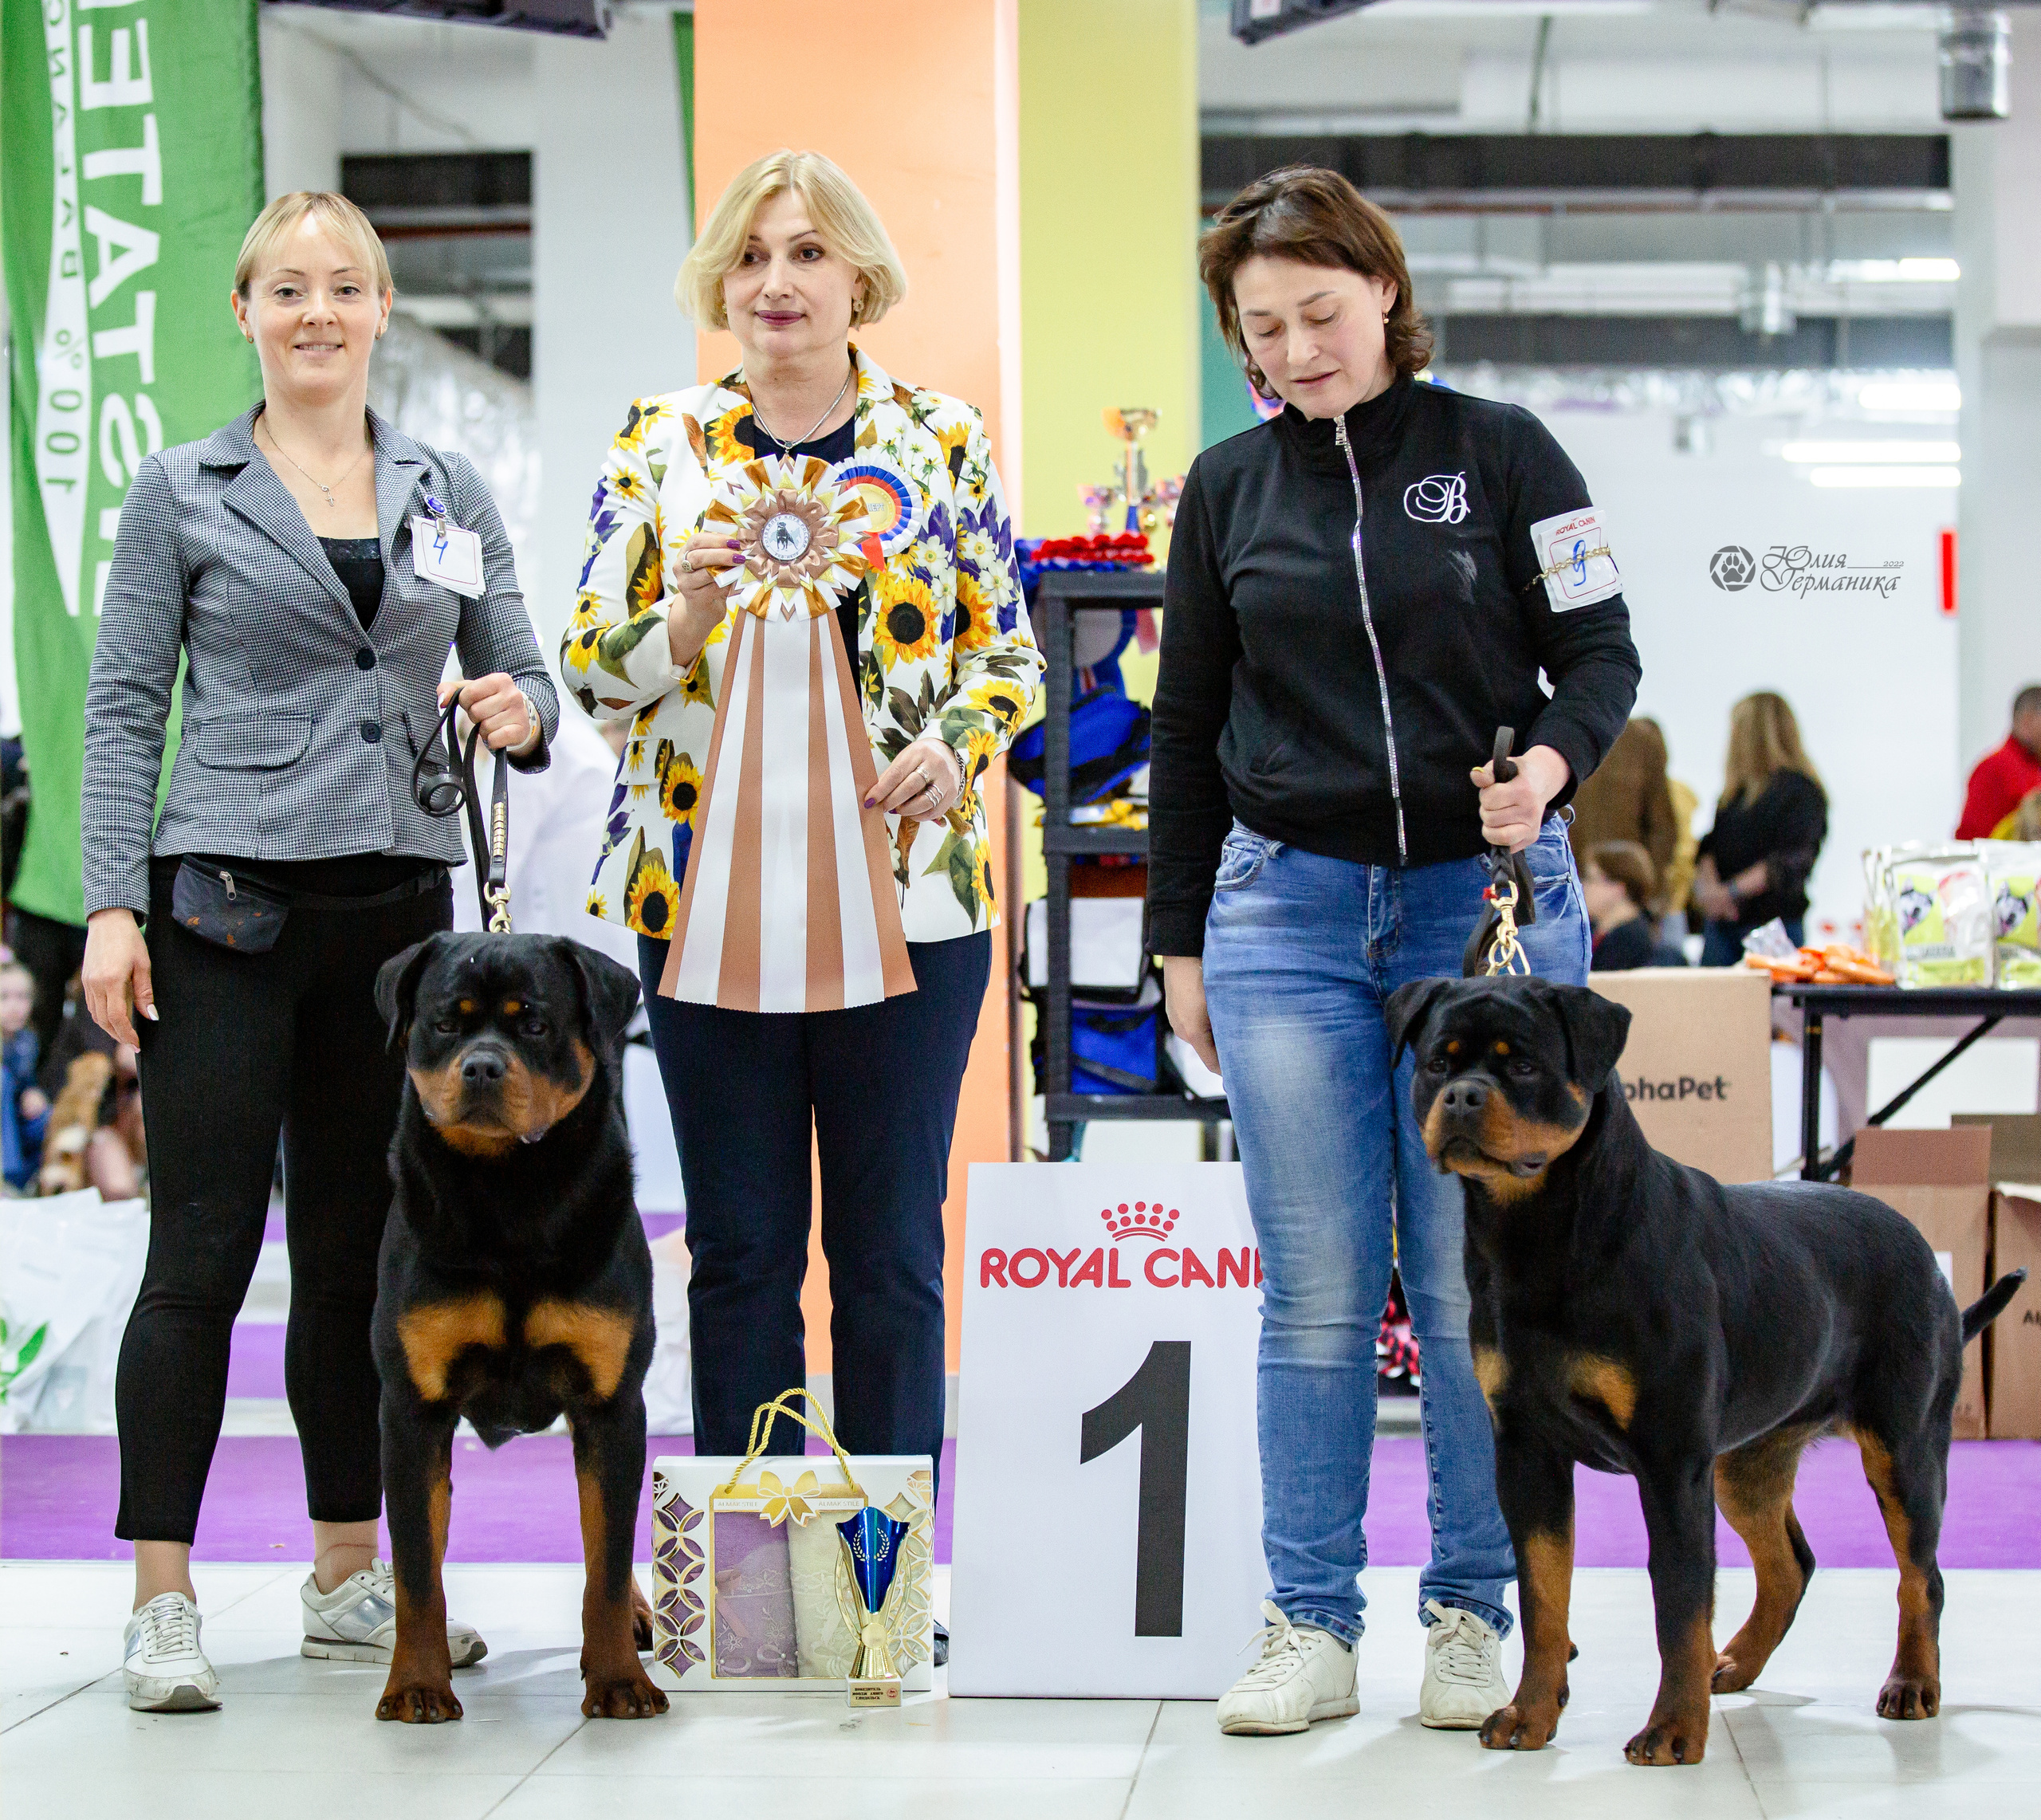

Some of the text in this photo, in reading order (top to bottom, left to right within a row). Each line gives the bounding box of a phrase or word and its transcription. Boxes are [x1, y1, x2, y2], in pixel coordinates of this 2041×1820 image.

[1555, 522, 1579, 537] ROYAL
[1578, 516, 1596, 528] CANIN
[433, 533, 449, 565] 4
[980, 1247, 1131, 1289] ROYAL
[1079, 1340, 1192, 1637] 1
